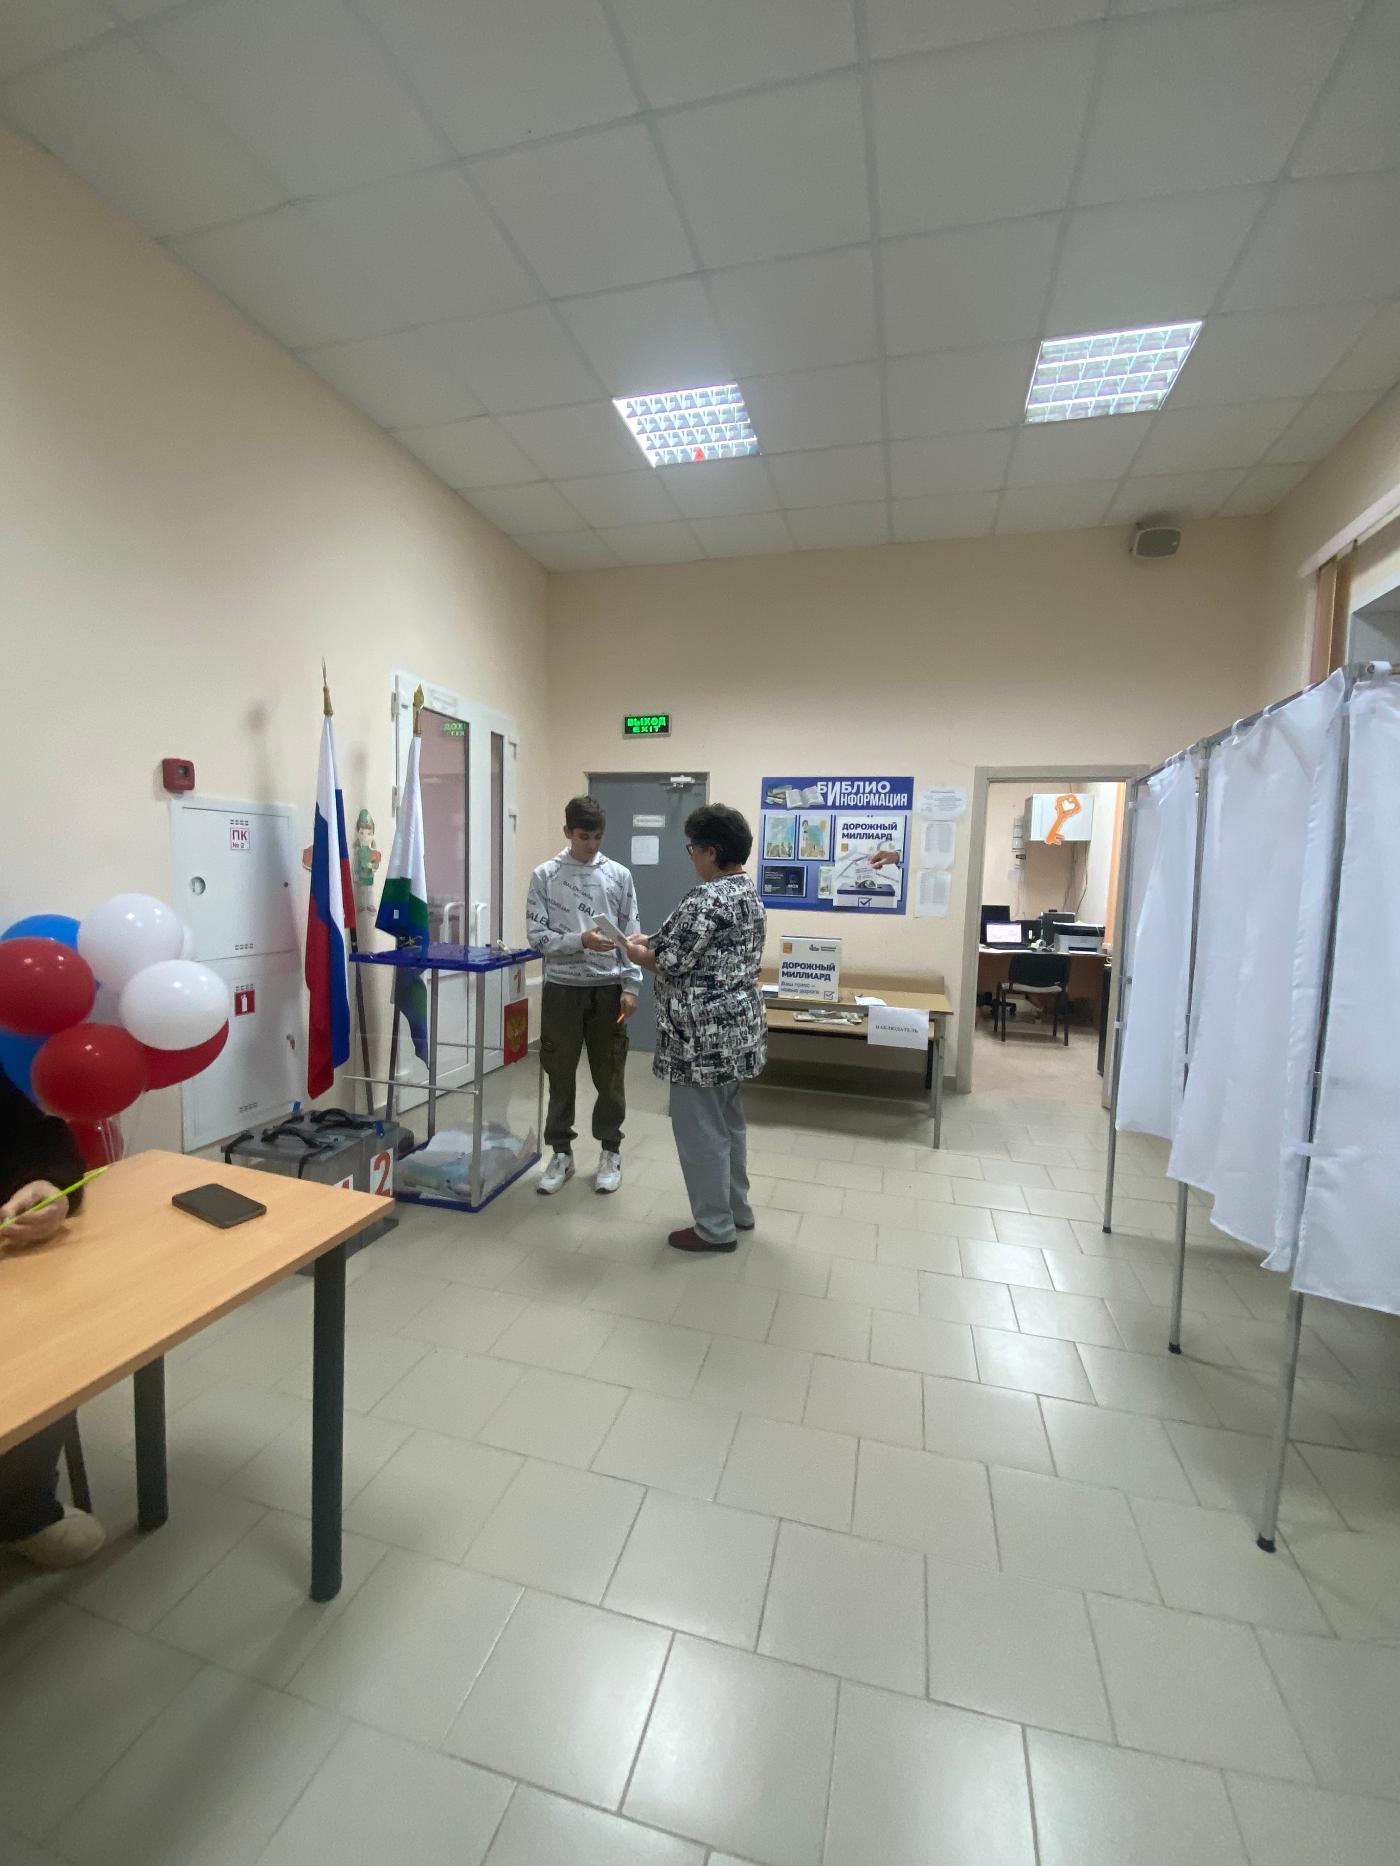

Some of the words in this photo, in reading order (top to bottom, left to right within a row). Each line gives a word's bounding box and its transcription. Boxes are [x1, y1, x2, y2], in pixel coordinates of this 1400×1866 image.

[627, 717, 666, 727] ВЫХОД
[817, 781, 891, 806] БИБЛИО
[841, 822, 898, 831] ДОРОЖНЫЙ
[232, 829, 248, 841] ПК
[841, 832, 893, 841] МИЛЛИАРД
[781, 961, 836, 972] ДОРОЖНЫЙ
[781, 970, 832, 982] МИЛЛИАРД
[373, 1151, 391, 1197] 2
